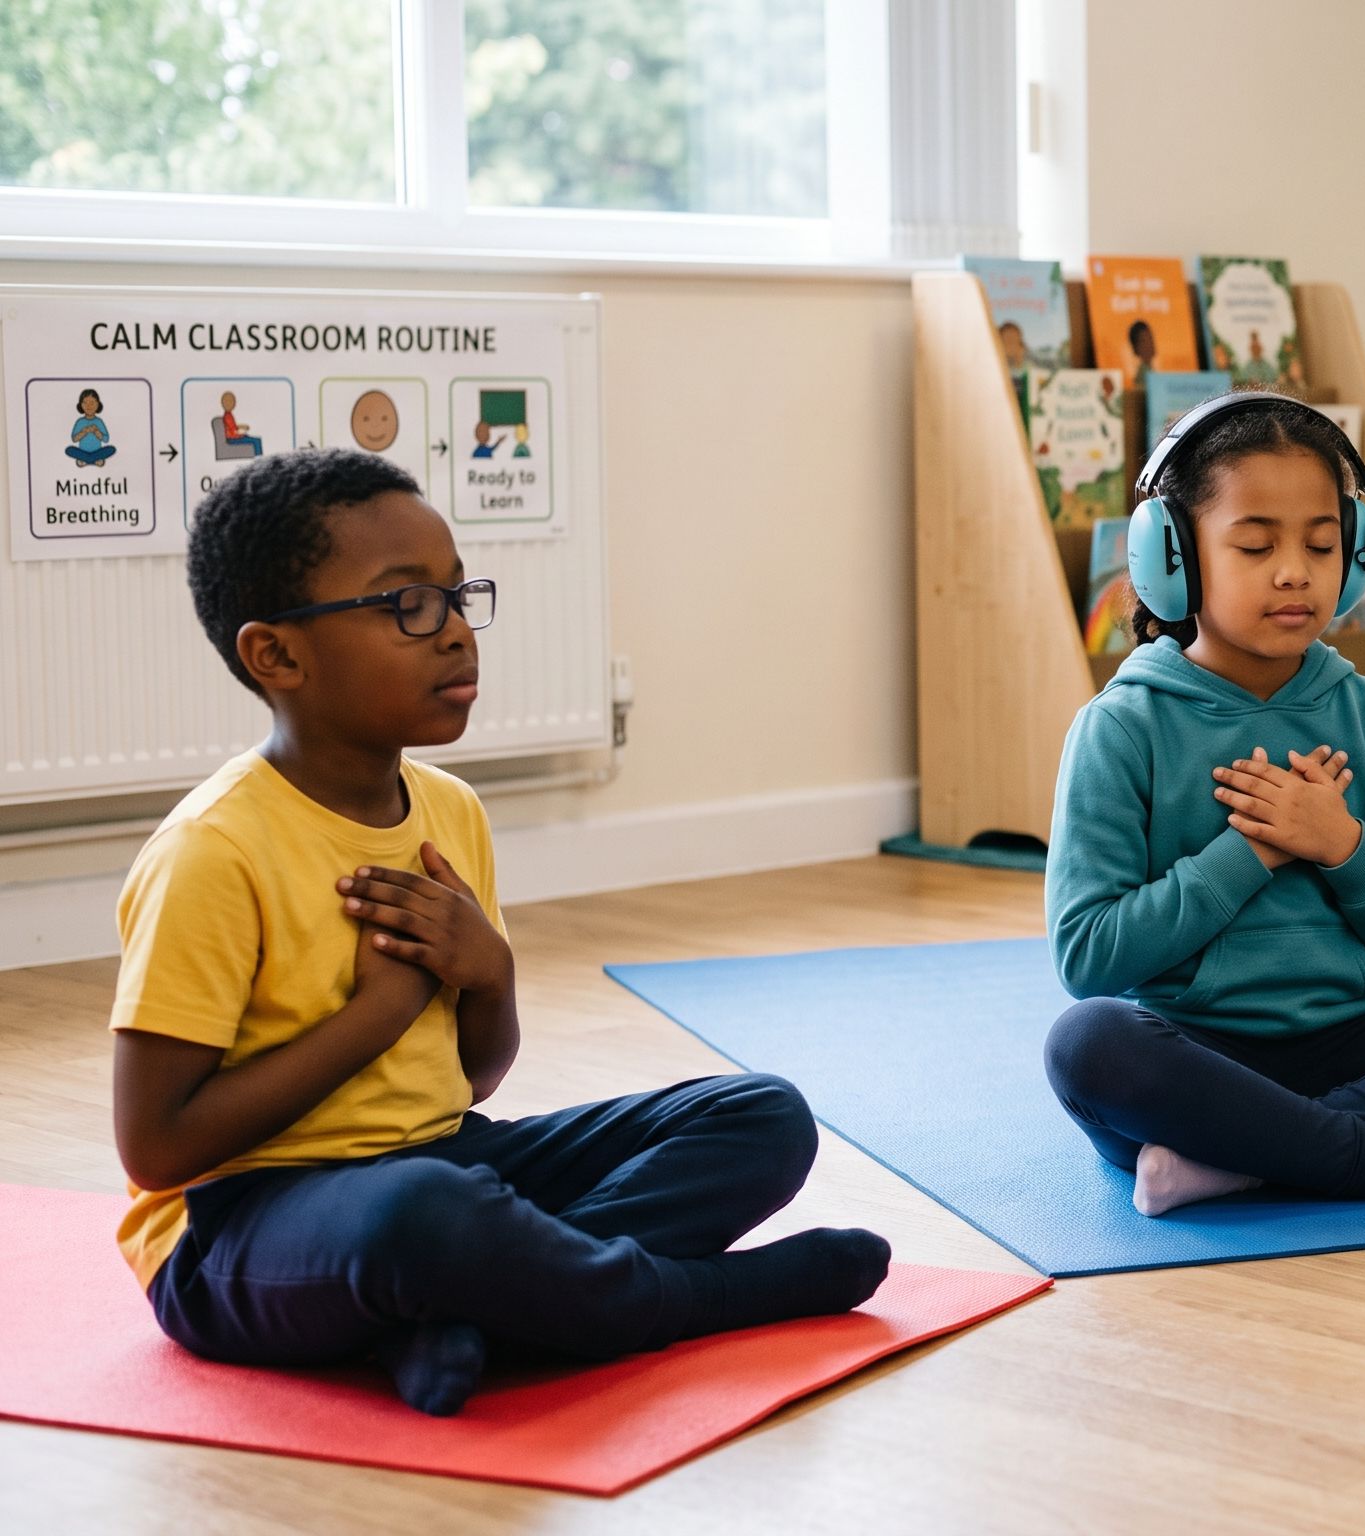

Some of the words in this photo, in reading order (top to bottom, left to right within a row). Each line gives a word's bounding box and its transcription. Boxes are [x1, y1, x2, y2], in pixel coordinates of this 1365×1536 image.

[90, 322, 177, 351] CALM
[188, 324, 367, 351] CLASSROOM
[378, 326, 497, 352] ROUTINE
[56, 477, 128, 496] Mindful
[467, 469, 515, 490] Ready
[519, 470, 535, 484] to
[480, 493, 524, 509] Learn
[46, 504, 139, 527] Breathing
